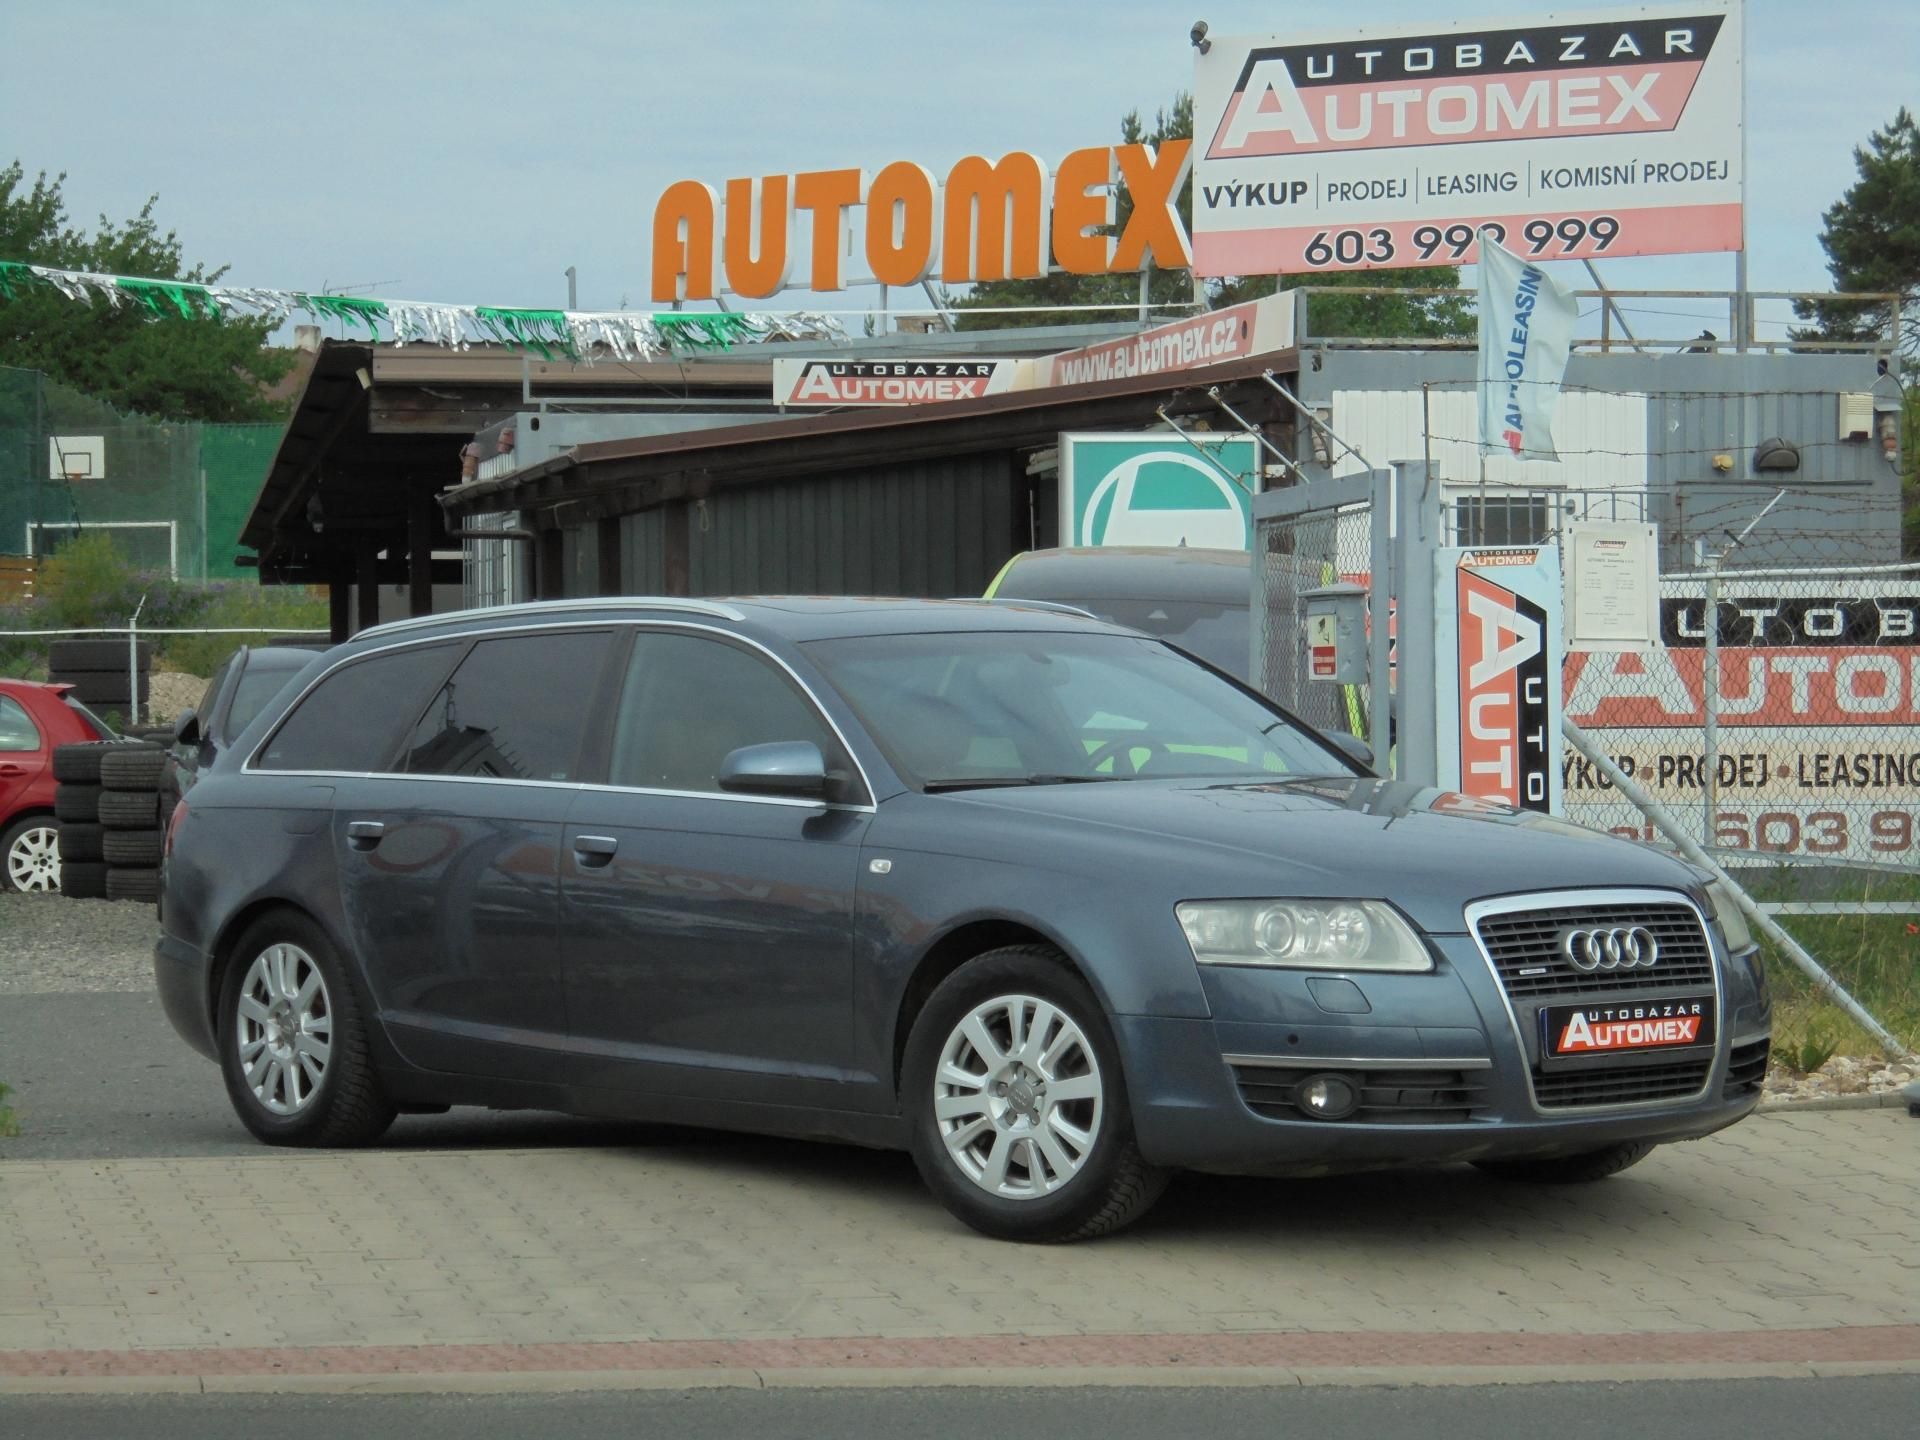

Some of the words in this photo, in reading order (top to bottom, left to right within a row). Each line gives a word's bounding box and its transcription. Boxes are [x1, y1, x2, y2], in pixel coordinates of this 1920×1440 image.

[1220, 59, 1662, 149] AUTOMEX
[1203, 178, 1308, 209] VÝKUP
[1327, 178, 1407, 202] PRODEJ
[1427, 171, 1518, 196] LEASING
[1541, 158, 1637, 189] KOMISNÍ
[1643, 160, 1728, 184] PRODEJ
[651, 140, 1192, 302] AUTOMEX
[1304, 228, 1395, 266] 603
[1522, 215, 1620, 257] 999
[1062, 317, 1237, 386] www.automex.cz
[797, 364, 976, 400] AUTOMEX
[1459, 551, 1533, 567] AUTOMEX
[1468, 589, 1541, 804] AUT
[1565, 652, 1920, 716] AUTO
[1799, 753, 1920, 788] LEASING
[1715, 811, 1848, 852] 603
[1869, 810, 1920, 852] 9
[1563, 1013, 1693, 1048] AUTOMEX
